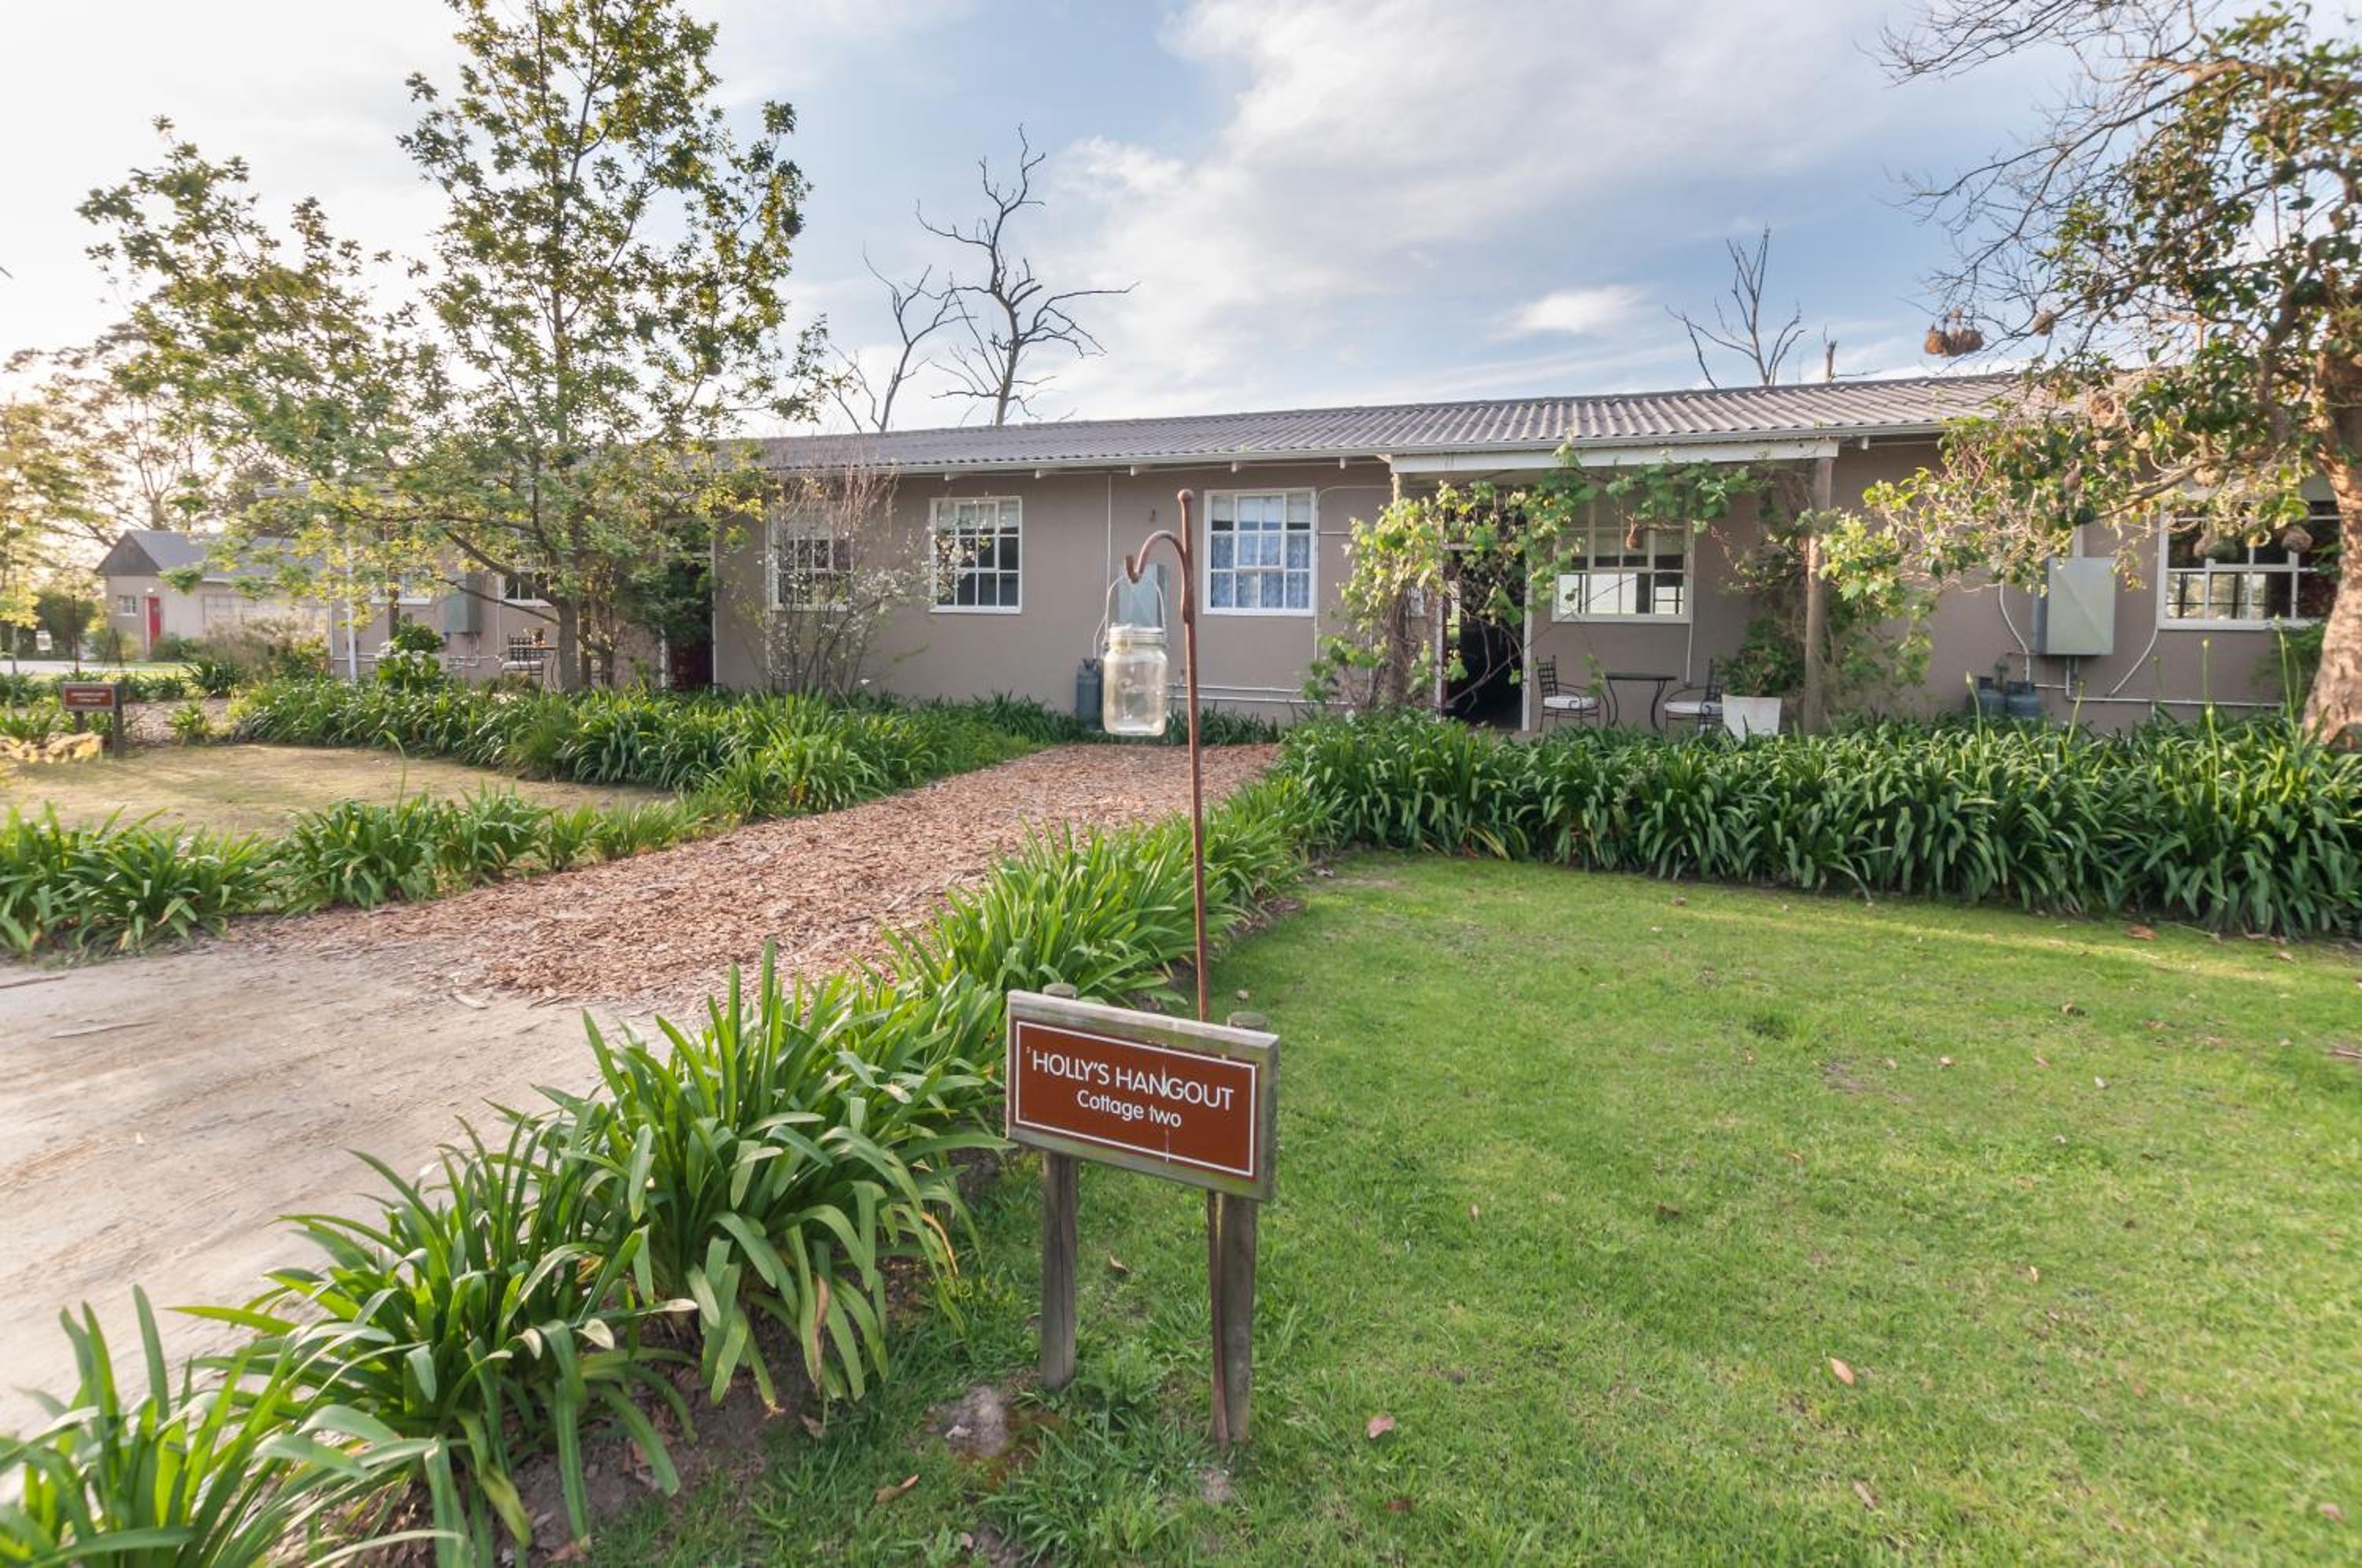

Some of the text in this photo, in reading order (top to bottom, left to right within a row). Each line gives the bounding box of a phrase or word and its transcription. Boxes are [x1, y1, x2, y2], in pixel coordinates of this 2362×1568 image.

[1032, 1049, 1235, 1111] HOLLY'S HANGOUT
[1076, 1089, 1182, 1127] Cottage two
